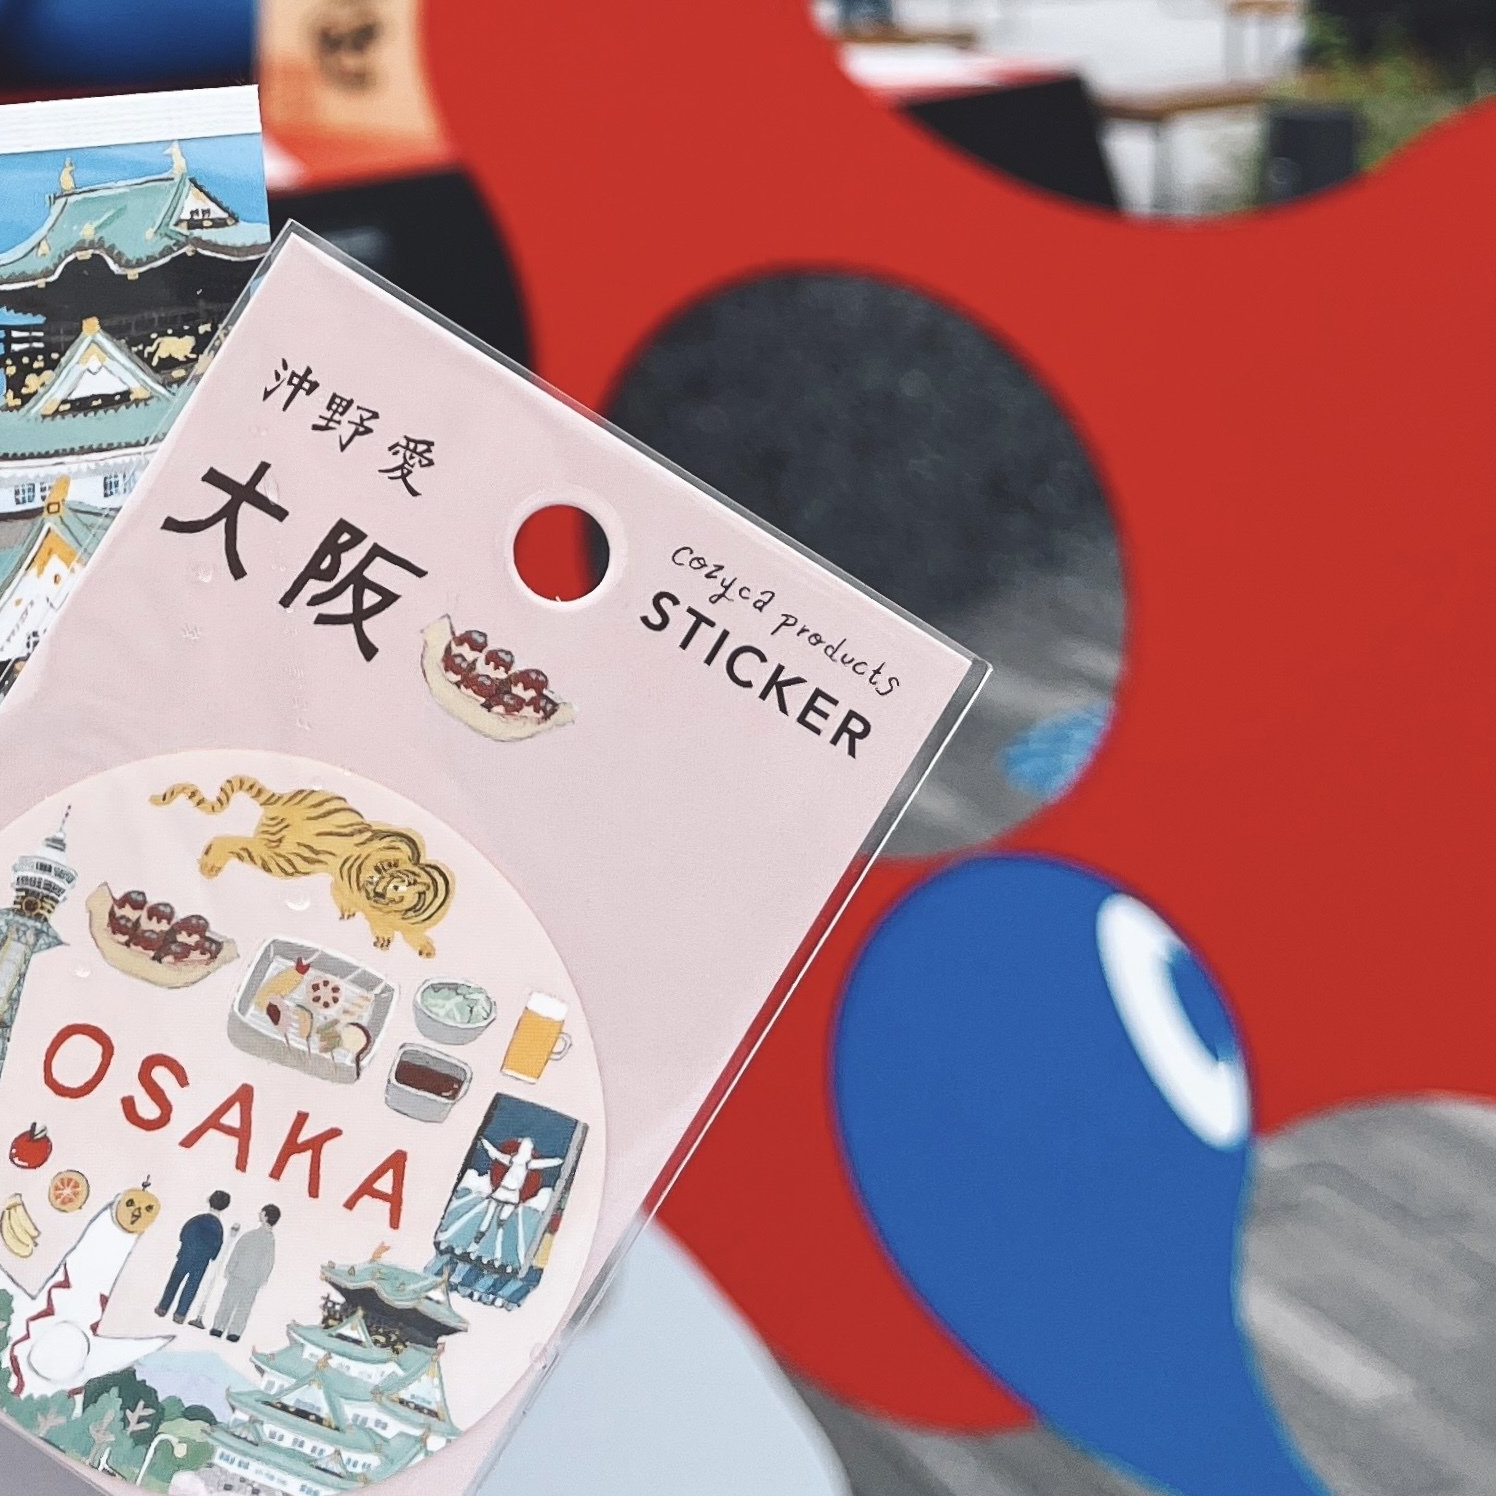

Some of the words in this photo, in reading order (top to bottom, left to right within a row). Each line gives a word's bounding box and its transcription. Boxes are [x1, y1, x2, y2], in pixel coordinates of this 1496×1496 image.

[262, 357, 436, 498] 沖野愛
[160, 460, 429, 663] 大阪
[639, 590, 872, 760] STICKER
[770, 613, 900, 696] products
[42, 1023, 408, 1231] OSAKA
